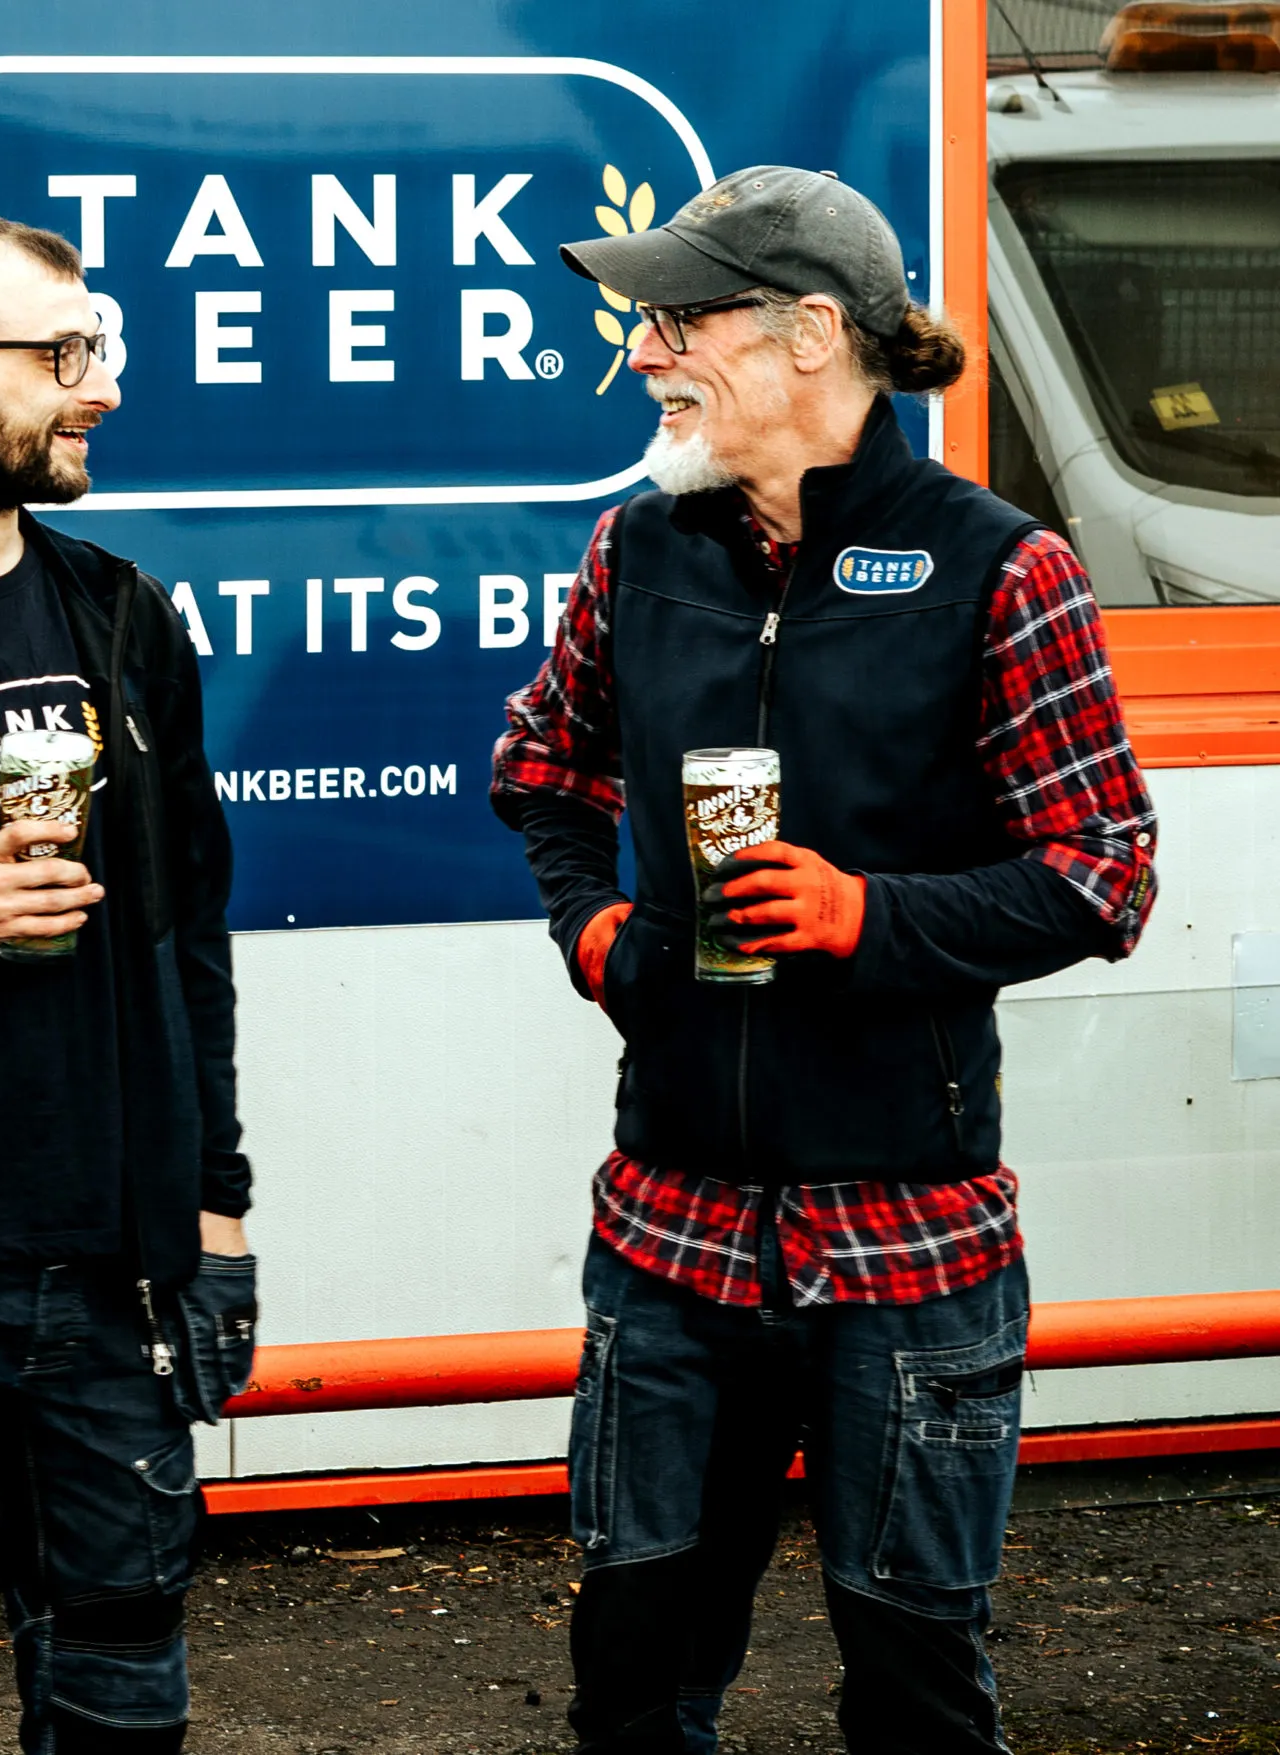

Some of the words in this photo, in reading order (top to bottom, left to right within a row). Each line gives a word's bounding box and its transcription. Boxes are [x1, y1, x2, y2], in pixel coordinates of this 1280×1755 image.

[48, 173, 536, 269] TANK
[855, 571, 911, 583] BEER
[857, 559, 914, 572] TANK
[306, 575, 443, 653] ITS
[697, 784, 756, 818] INNIS
